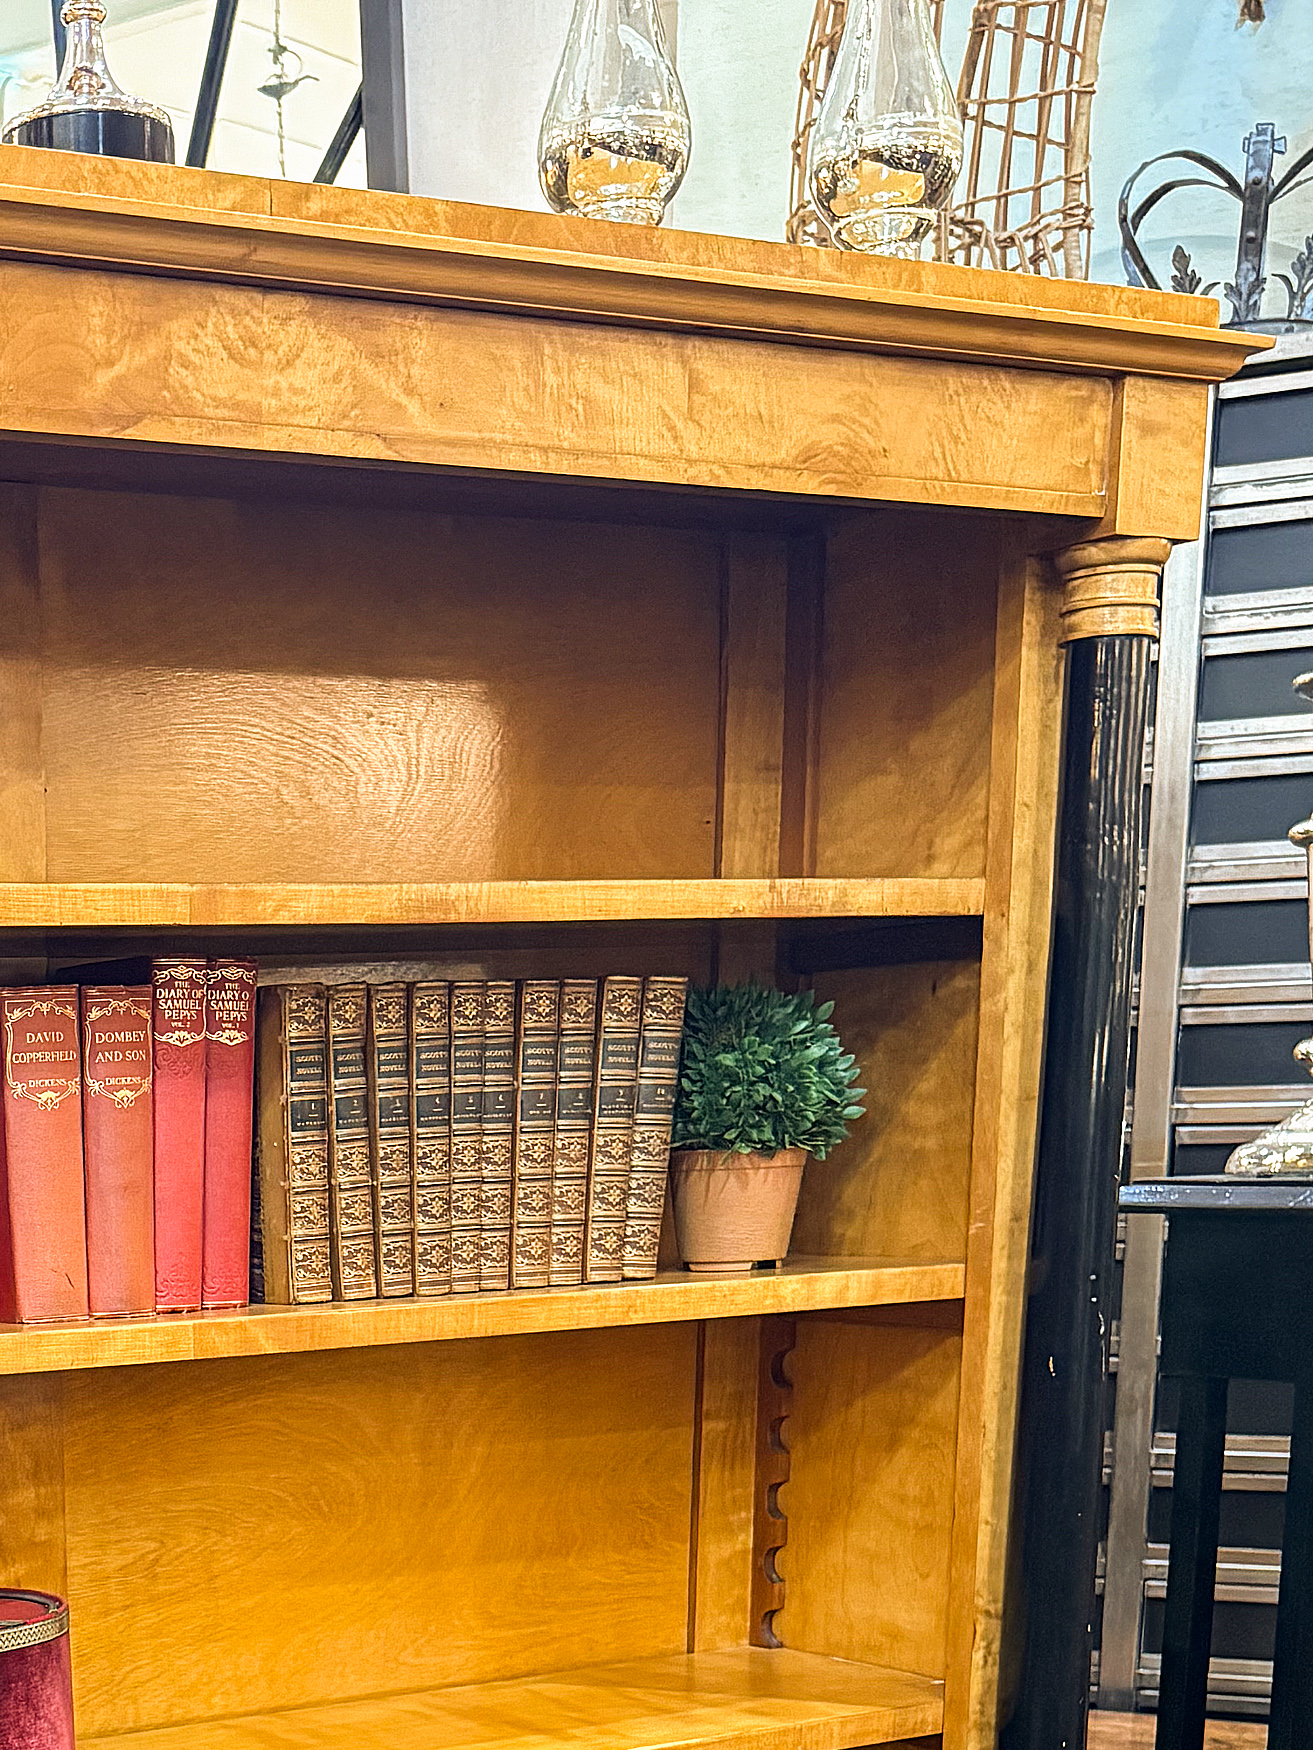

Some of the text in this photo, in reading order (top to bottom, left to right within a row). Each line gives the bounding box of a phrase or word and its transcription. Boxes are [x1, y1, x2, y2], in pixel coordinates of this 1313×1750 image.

[174, 981, 190, 989] THE
[156, 988, 205, 999] DIARY OF
[207, 989, 240, 1000] DIARY
[158, 999, 202, 1010] SAMUEL
[164, 1010, 197, 1020] PEPYS
[215, 1011, 248, 1021] PEPYS
[26, 1032, 64, 1043] DAVID
[95, 1031, 146, 1043] DOMBEY
[12, 1050, 77, 1063] COPPERFIELD
[95, 1050, 146, 1063] AND SON
[28, 1078, 68, 1088] DICKENS
[105, 1077, 142, 1086] DICKENS
